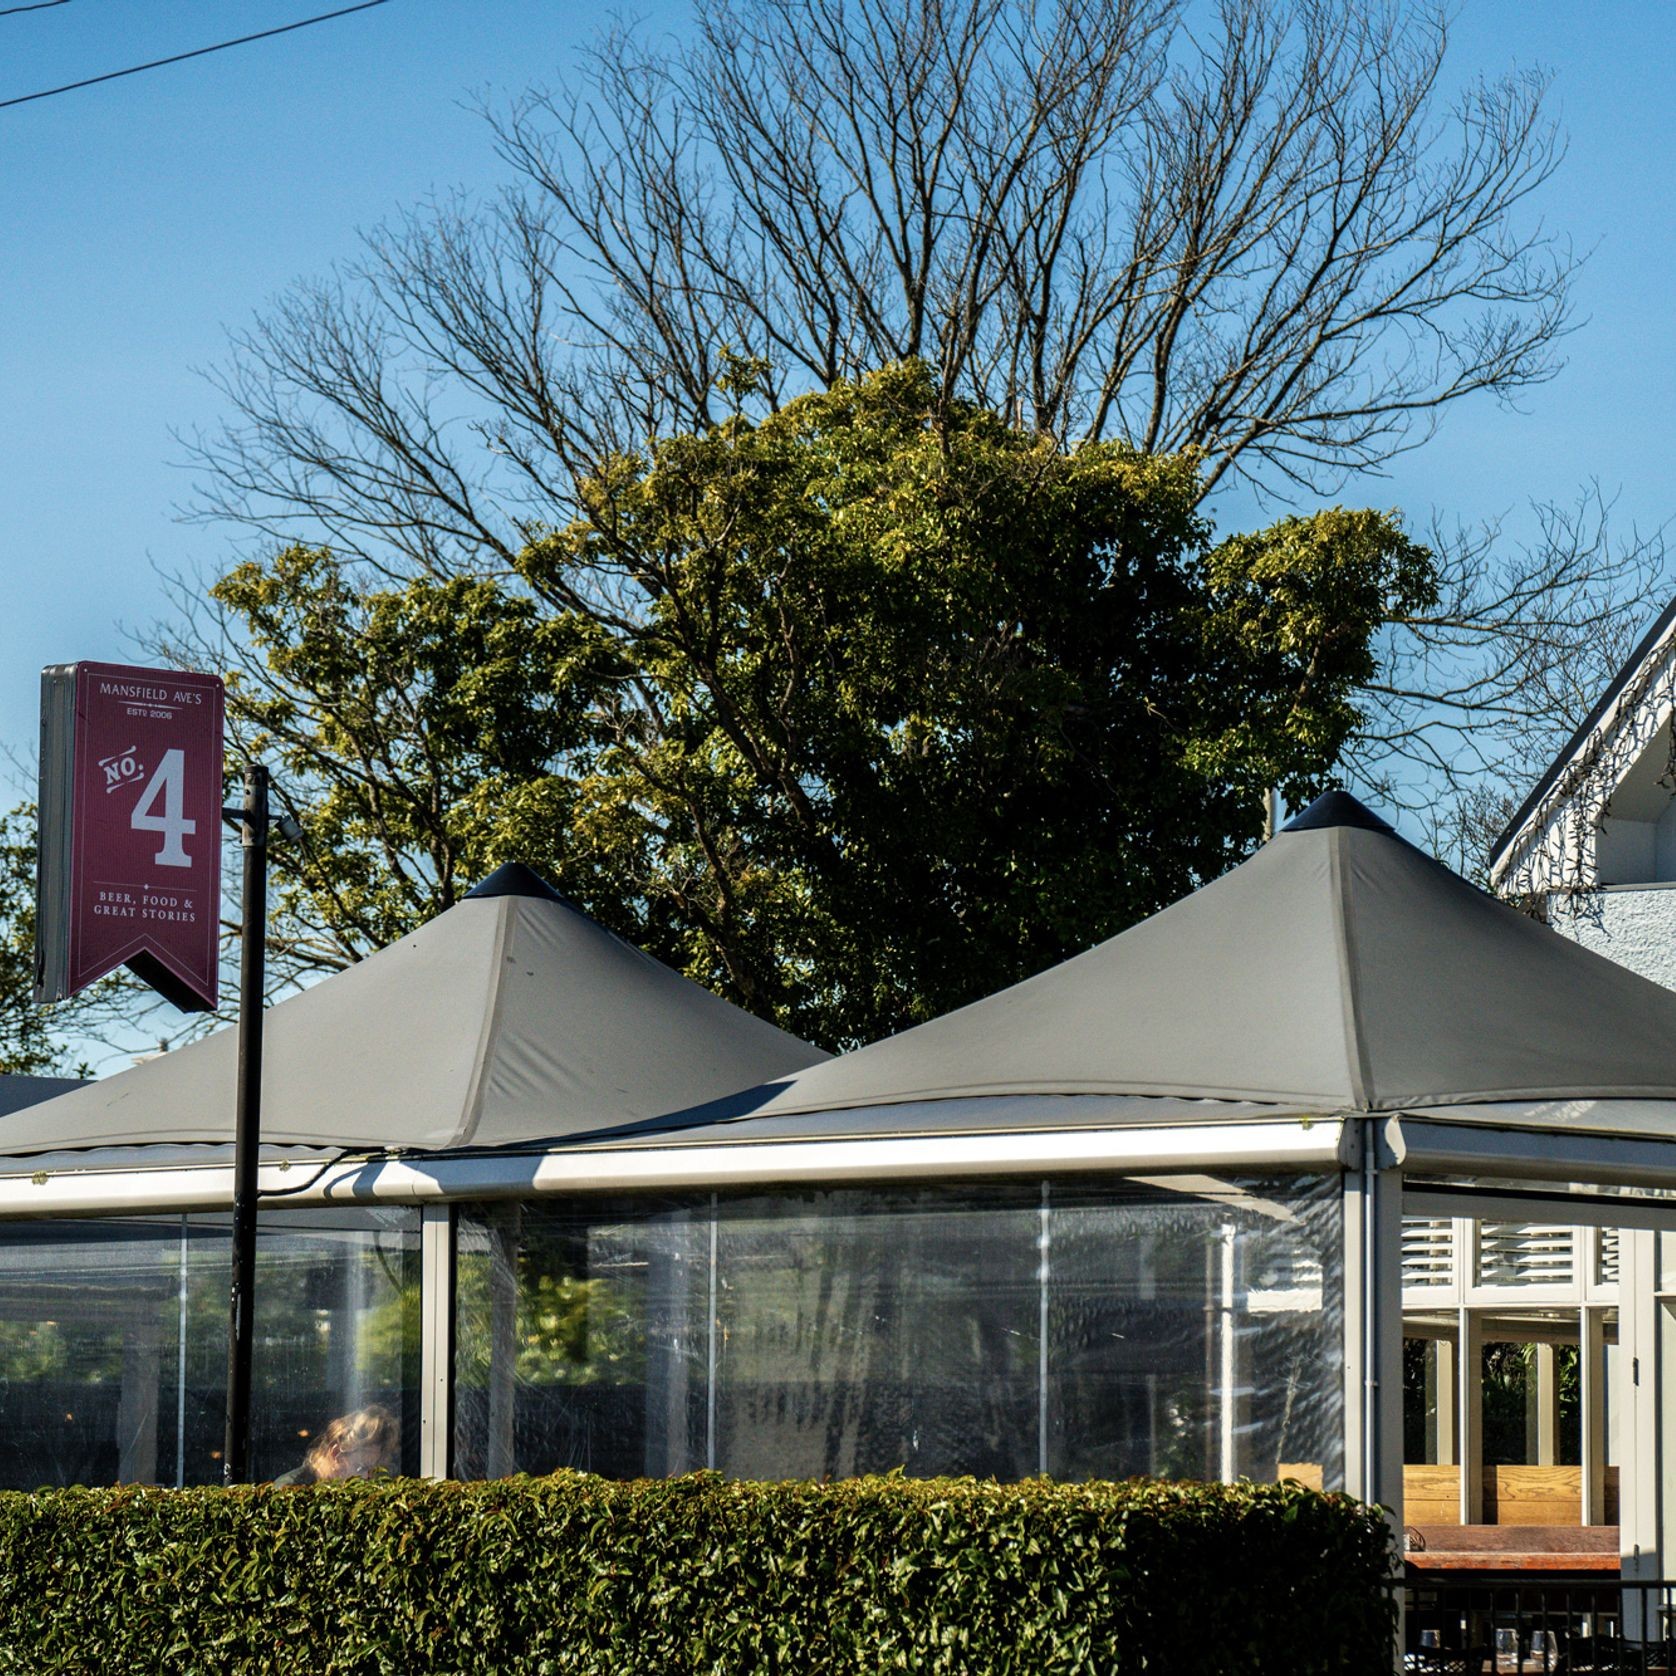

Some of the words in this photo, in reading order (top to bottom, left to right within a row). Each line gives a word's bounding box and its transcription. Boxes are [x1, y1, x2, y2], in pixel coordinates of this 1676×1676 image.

[100, 682, 168, 700] MANSFIELD
[173, 691, 202, 705] AVE'S
[104, 757, 143, 784] NO.
[131, 748, 196, 868] 4
[100, 891, 136, 905] BEER,
[143, 895, 178, 907] FOOD
[184, 899, 193, 909] &
[94, 905, 136, 917] GREAT
[142, 909, 196, 922] STORIES
